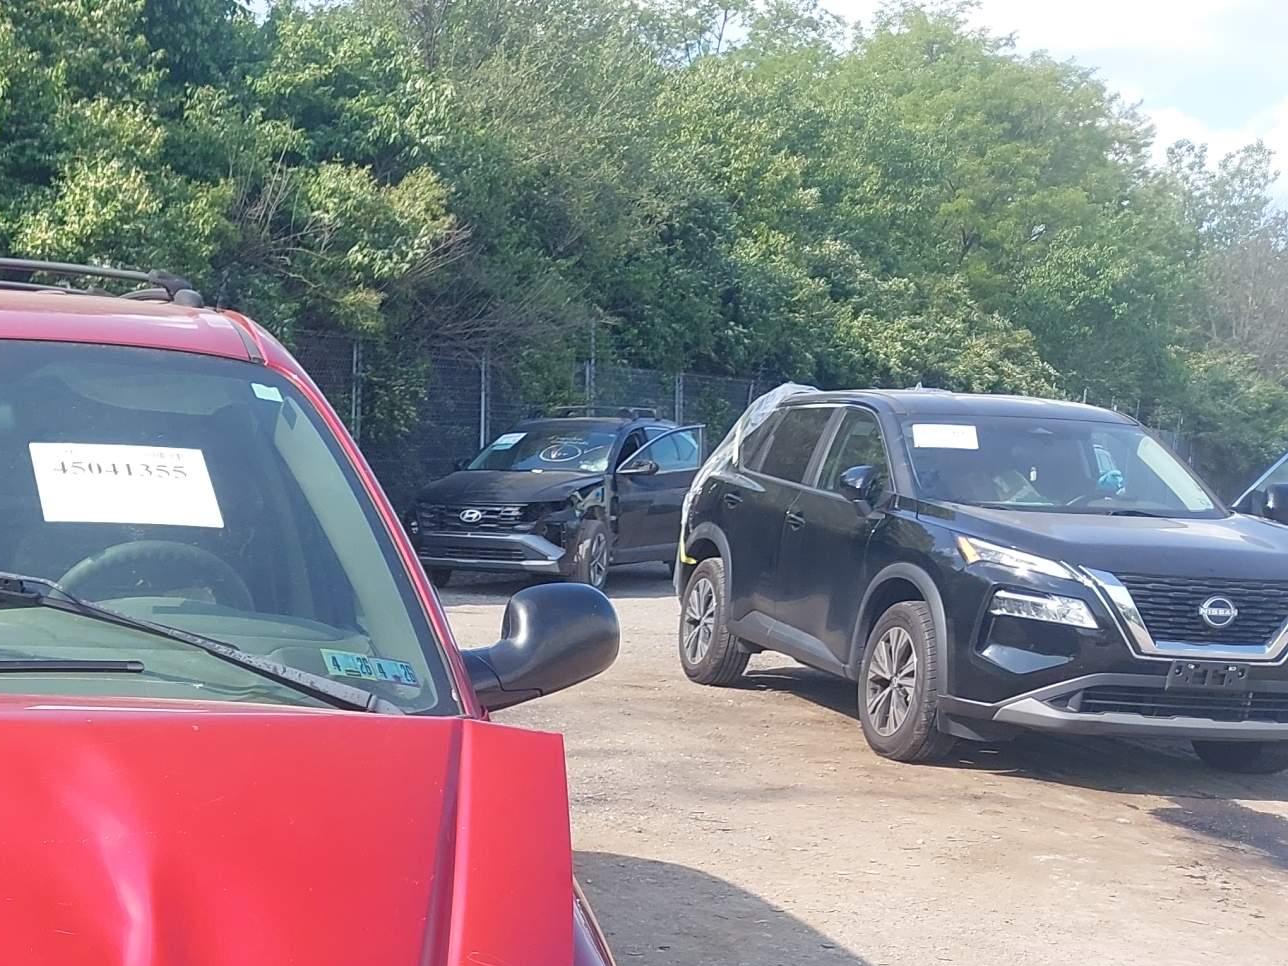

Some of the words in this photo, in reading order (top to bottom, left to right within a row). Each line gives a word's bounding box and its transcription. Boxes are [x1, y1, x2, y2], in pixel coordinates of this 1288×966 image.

[53, 461, 187, 479] 45041355
[1198, 607, 1238, 617] NISSAN
[331, 655, 342, 672] 4
[356, 656, 372, 675] 26
[376, 662, 388, 679] 4
